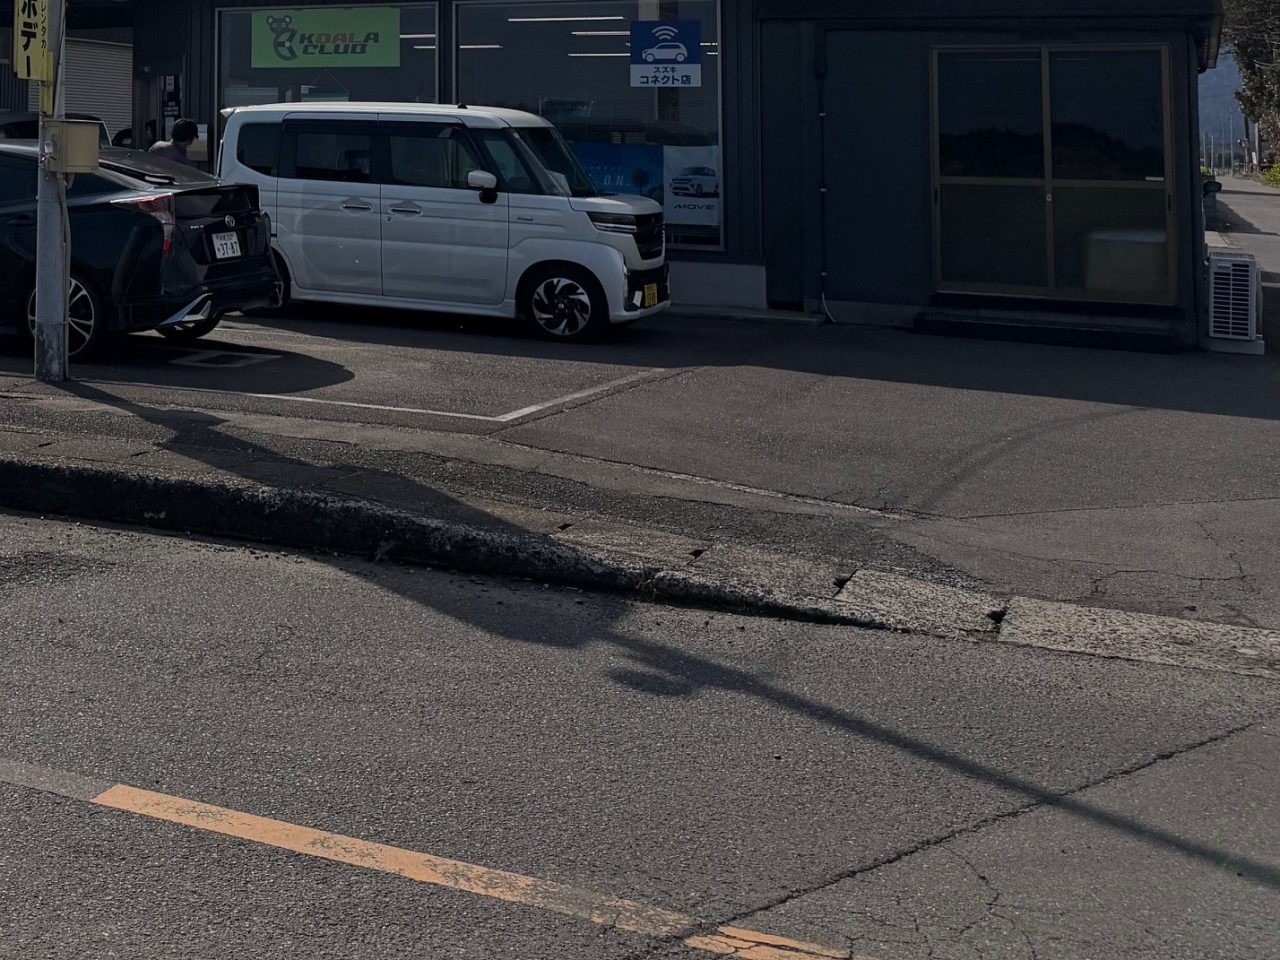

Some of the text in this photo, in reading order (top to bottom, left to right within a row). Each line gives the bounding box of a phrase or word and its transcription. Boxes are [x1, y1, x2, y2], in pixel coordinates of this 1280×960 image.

[299, 32, 380, 44] KOALA
[302, 43, 368, 55] CLUB
[654, 66, 677, 74] スズキ
[640, 75, 692, 85] コネクト店
